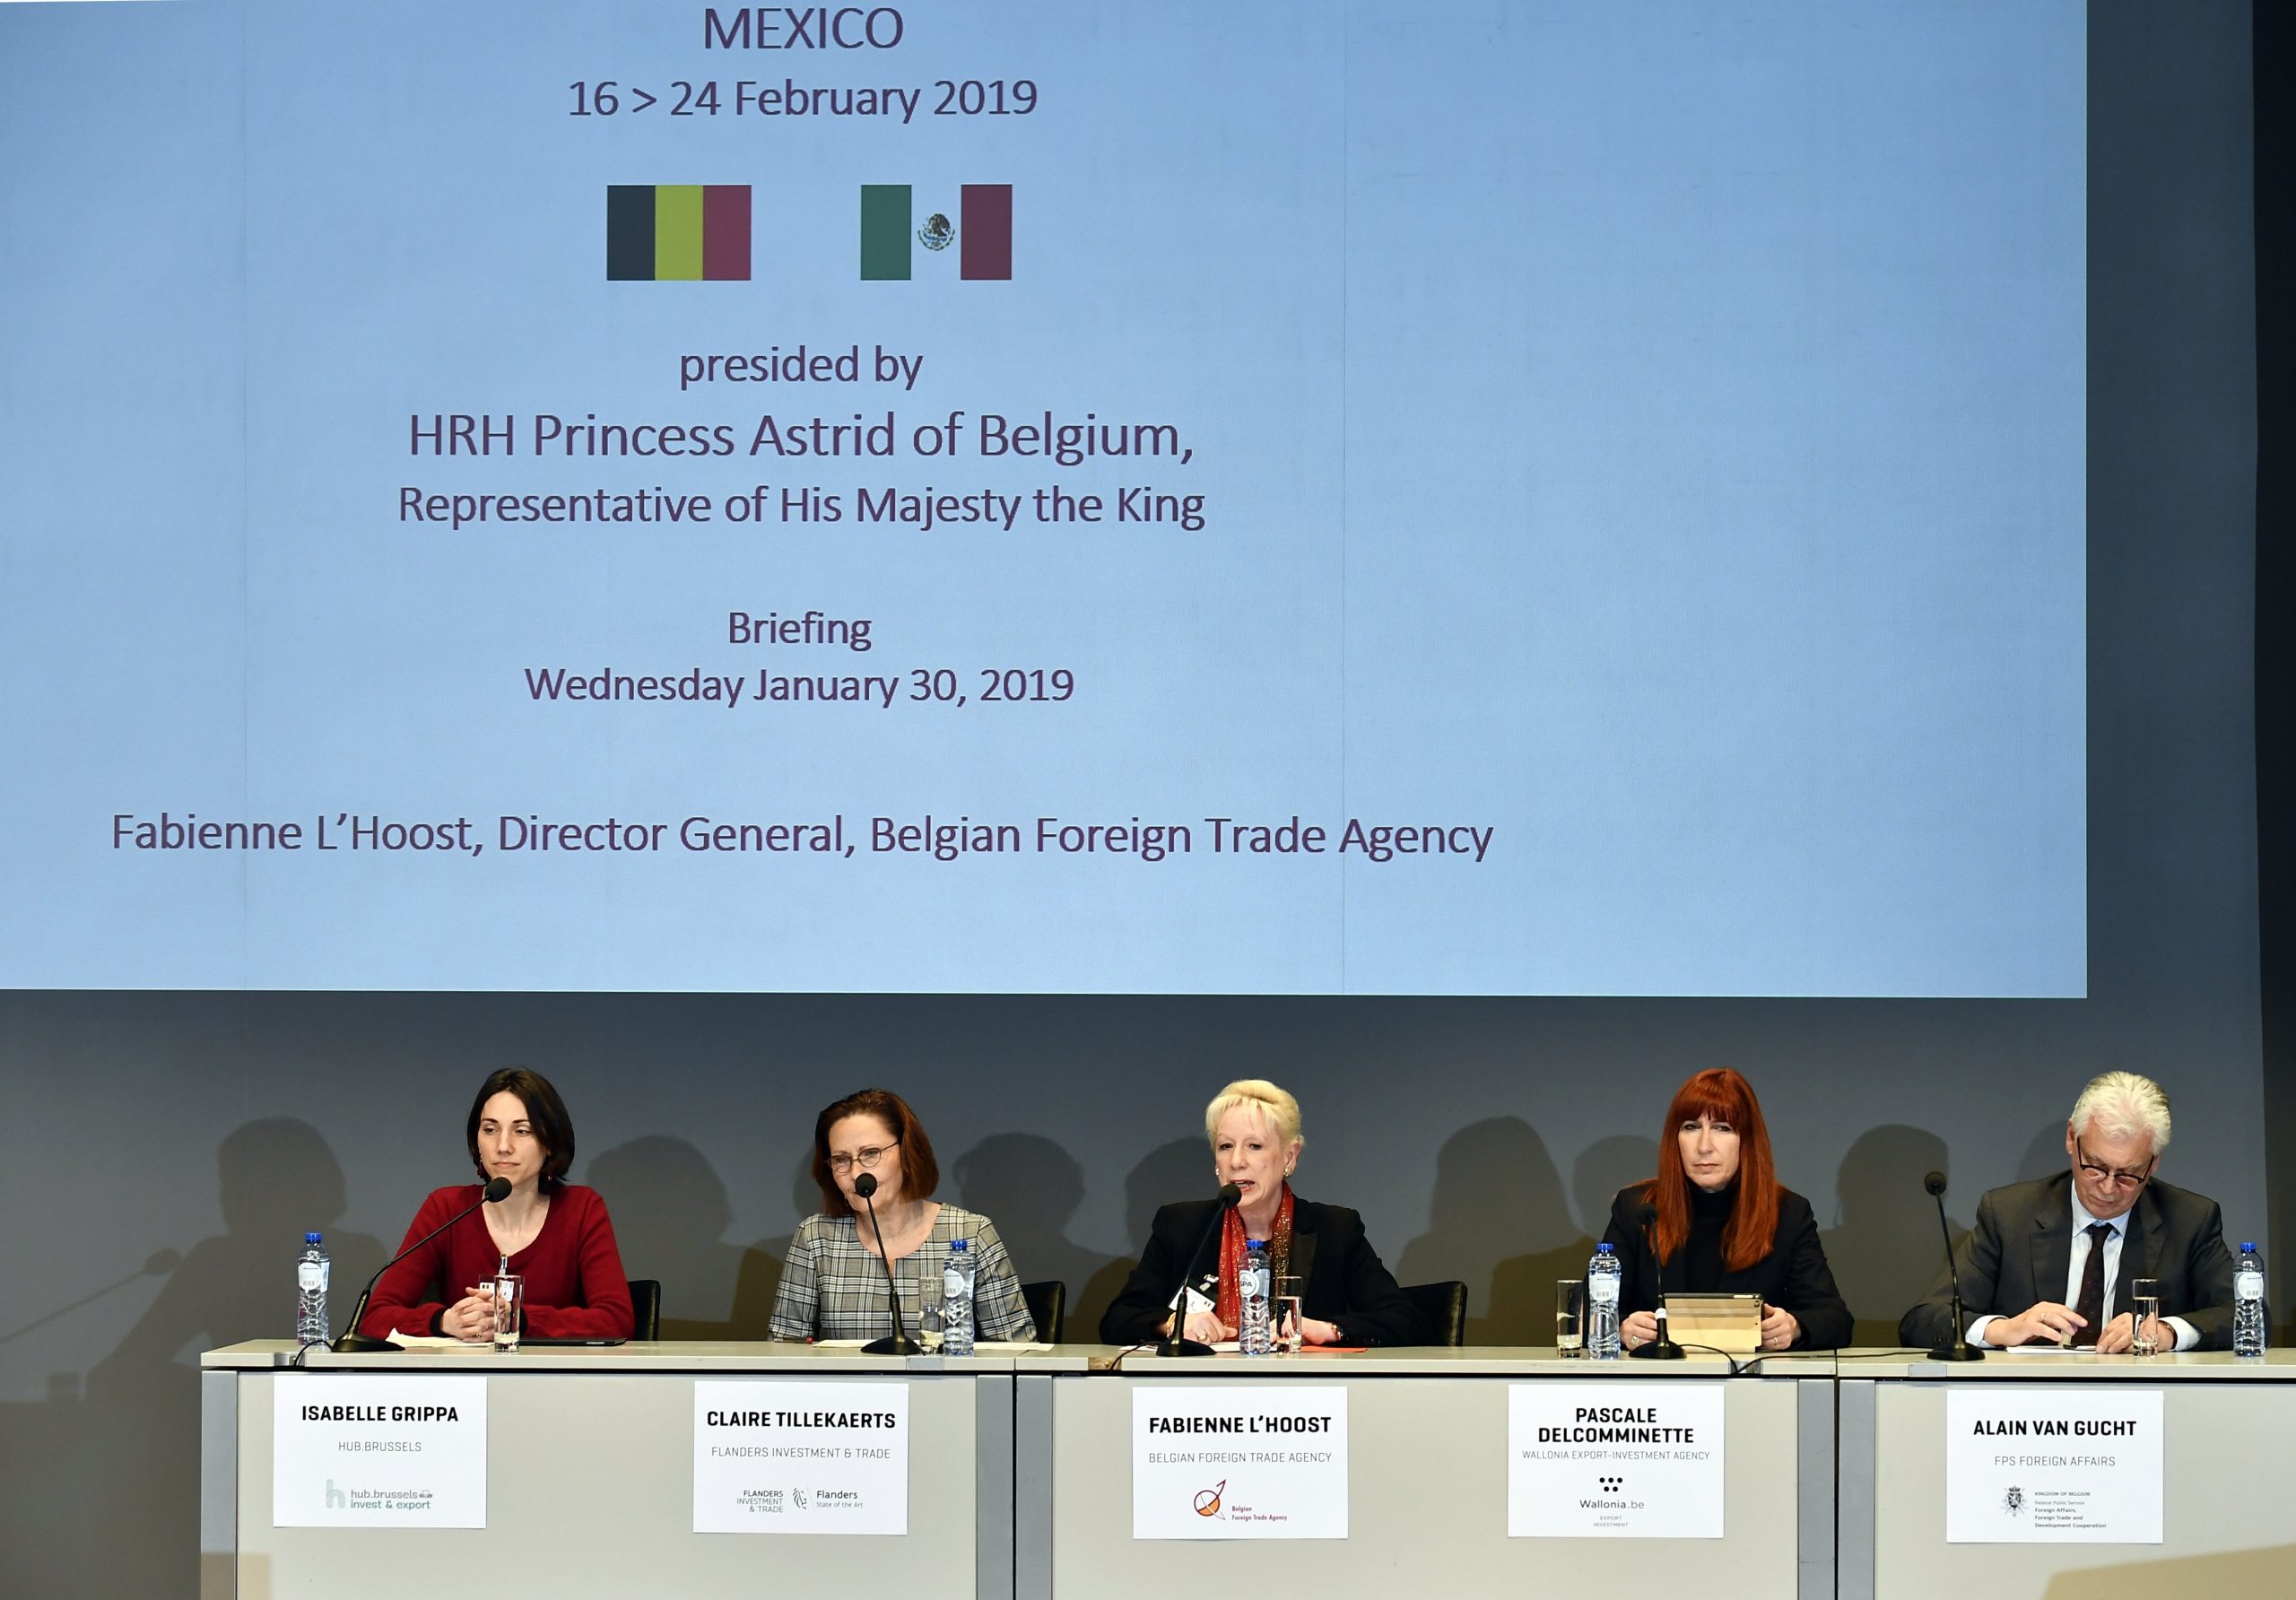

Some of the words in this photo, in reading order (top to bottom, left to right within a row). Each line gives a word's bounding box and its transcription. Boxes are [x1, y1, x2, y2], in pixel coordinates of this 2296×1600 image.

[705, 7, 903, 49] MEXICO
[570, 82, 619, 116] 16
[632, 88, 657, 113] >
[671, 82, 722, 116] 24
[736, 78, 921, 124] February
[934, 80, 1037, 115] 2019
[681, 345, 858, 391] presided
[875, 344, 924, 391] by
[411, 414, 514, 456] HRH
[535, 413, 735, 456] Princess
[749, 411, 894, 456] Astrid
[914, 411, 965, 456] of
[981, 411, 1192, 466] Belgium,
[400, 486, 711, 531] Representative
[726, 485, 770, 522] of
[782, 487, 841, 522] His
[857, 487, 1022, 531] Majesty
[1032, 485, 1103, 522] the
[1118, 486, 1205, 531] King
[729, 611, 872, 652] Briefing
[524, 667, 745, 709] Wednesday
[753, 669, 900, 709] January
[910, 669, 966, 708] 30,
[980, 669, 1074, 700] 2019
[114, 813, 302, 849] Fabienne
[500, 815, 667, 851] Director
[680, 814, 855, 858] General,
[873, 815, 1020, 861] Belgian
[1038, 817, 1190, 862] Foreign
[1205, 816, 1326, 853] Trade
[1338, 819, 1494, 863] Agency
[302, 1405, 387, 1422] ISABELLE
[392, 1406, 458, 1422] GRIPPA
[708, 1411, 770, 1427] CLAIRE
[776, 1412, 895, 1429] TILLEKAERTS
[1576, 1408, 1657, 1423] PASCALE
[1150, 1417, 1244, 1433] FABIENNE
[1973, 1421, 2027, 1435] ALAIN
[2032, 1421, 2068, 1436] VAN
[2074, 1421, 2136, 1436] GUCHT
[1539, 1428, 1693, 1443] DELCOMMINETTE
[338, 1441, 422, 1452] HUB.BRUSSELS
[711, 1447, 769, 1457] FLANDERS
[772, 1448, 840, 1458] INVESTMENT
[844, 1448, 852, 1458] &
[856, 1448, 890, 1459] TRADE
[1149, 1453, 1195, 1463] BELGIAN
[1199, 1452, 1246, 1463] FOREIGN
[1249, 1452, 1285, 1463] TRADE
[1289, 1452, 1332, 1463] AGENCY
[1522, 1450, 1570, 1459] WALLONIA
[1572, 1450, 1671, 1460] EXPORT-INVESTMENT
[1674, 1451, 1709, 1460] AGENCY
[1995, 1456, 2016, 1466] FPS
[2020, 1456, 2066, 1466] FOREIGN
[2070, 1457, 2115, 1466] AFFAIRS
[351, 1489, 418, 1499] hub.brussels
[744, 1490, 784, 1498] FLANDERS
[817, 1490, 857, 1500] Flanders
[351, 1500, 382, 1509] invest
[396, 1500, 430, 1510] export
[1579, 1500, 1644, 1509] Wallonia.be
